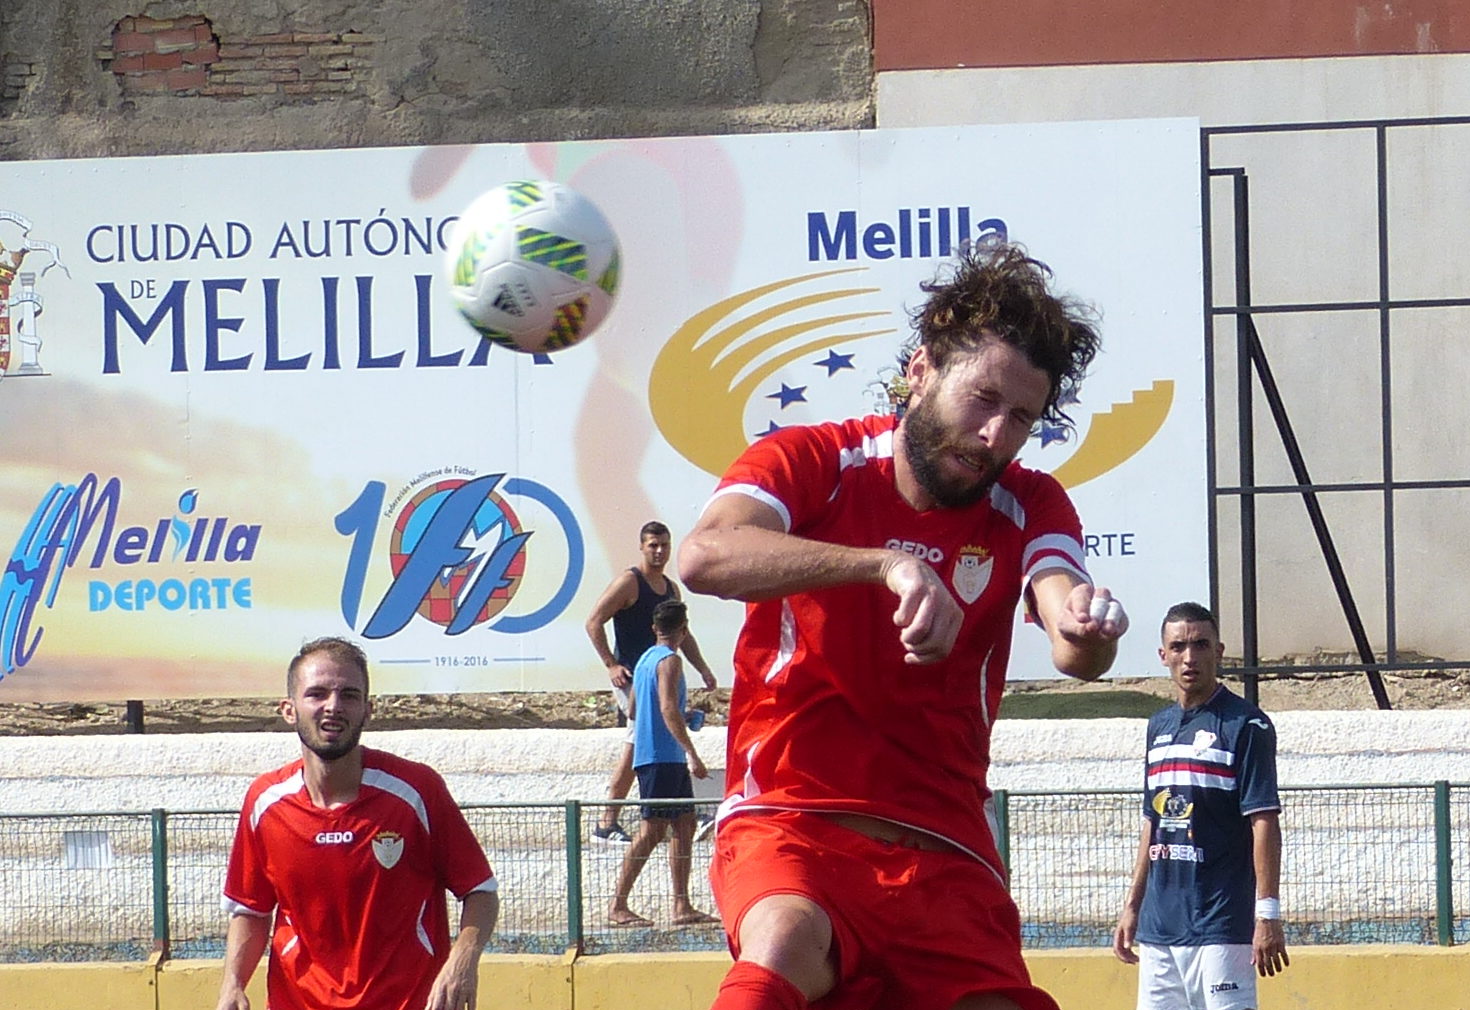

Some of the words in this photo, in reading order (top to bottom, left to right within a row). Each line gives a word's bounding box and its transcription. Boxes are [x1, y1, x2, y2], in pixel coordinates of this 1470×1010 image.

[86, 221, 252, 263] CIUDAD
[269, 208, 459, 260] AUTÓN
[130, 280, 157, 299] DE
[95, 274, 554, 375] MELILL
[885, 538, 944, 563] GEDO
[88, 577, 252, 612] DEPORTE
[435, 656, 489, 667] 1916-2016
[315, 831, 354, 844] GEDO
